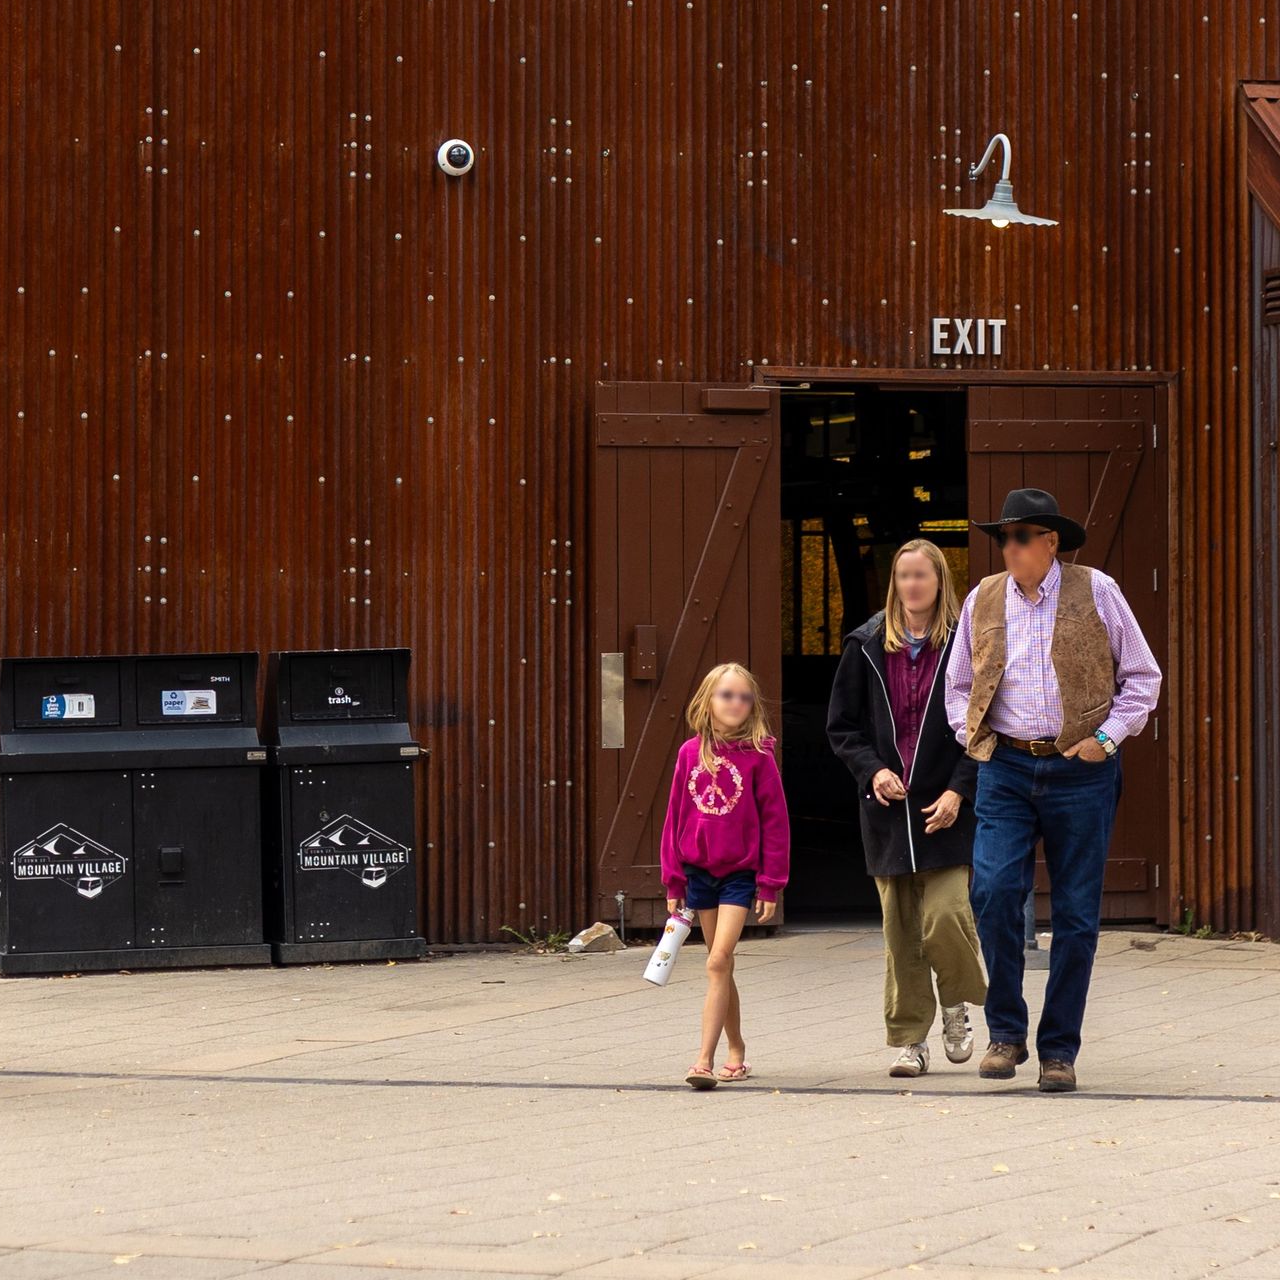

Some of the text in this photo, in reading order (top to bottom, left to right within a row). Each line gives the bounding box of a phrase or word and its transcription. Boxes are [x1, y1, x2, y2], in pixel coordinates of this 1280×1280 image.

[932, 318, 1007, 355] EXIT
[328, 695, 352, 705] trash
[304, 852, 405, 867] MOUNTAIN VILLAGE
[17, 862, 122, 876] MOUNTAIN VILLAGE
